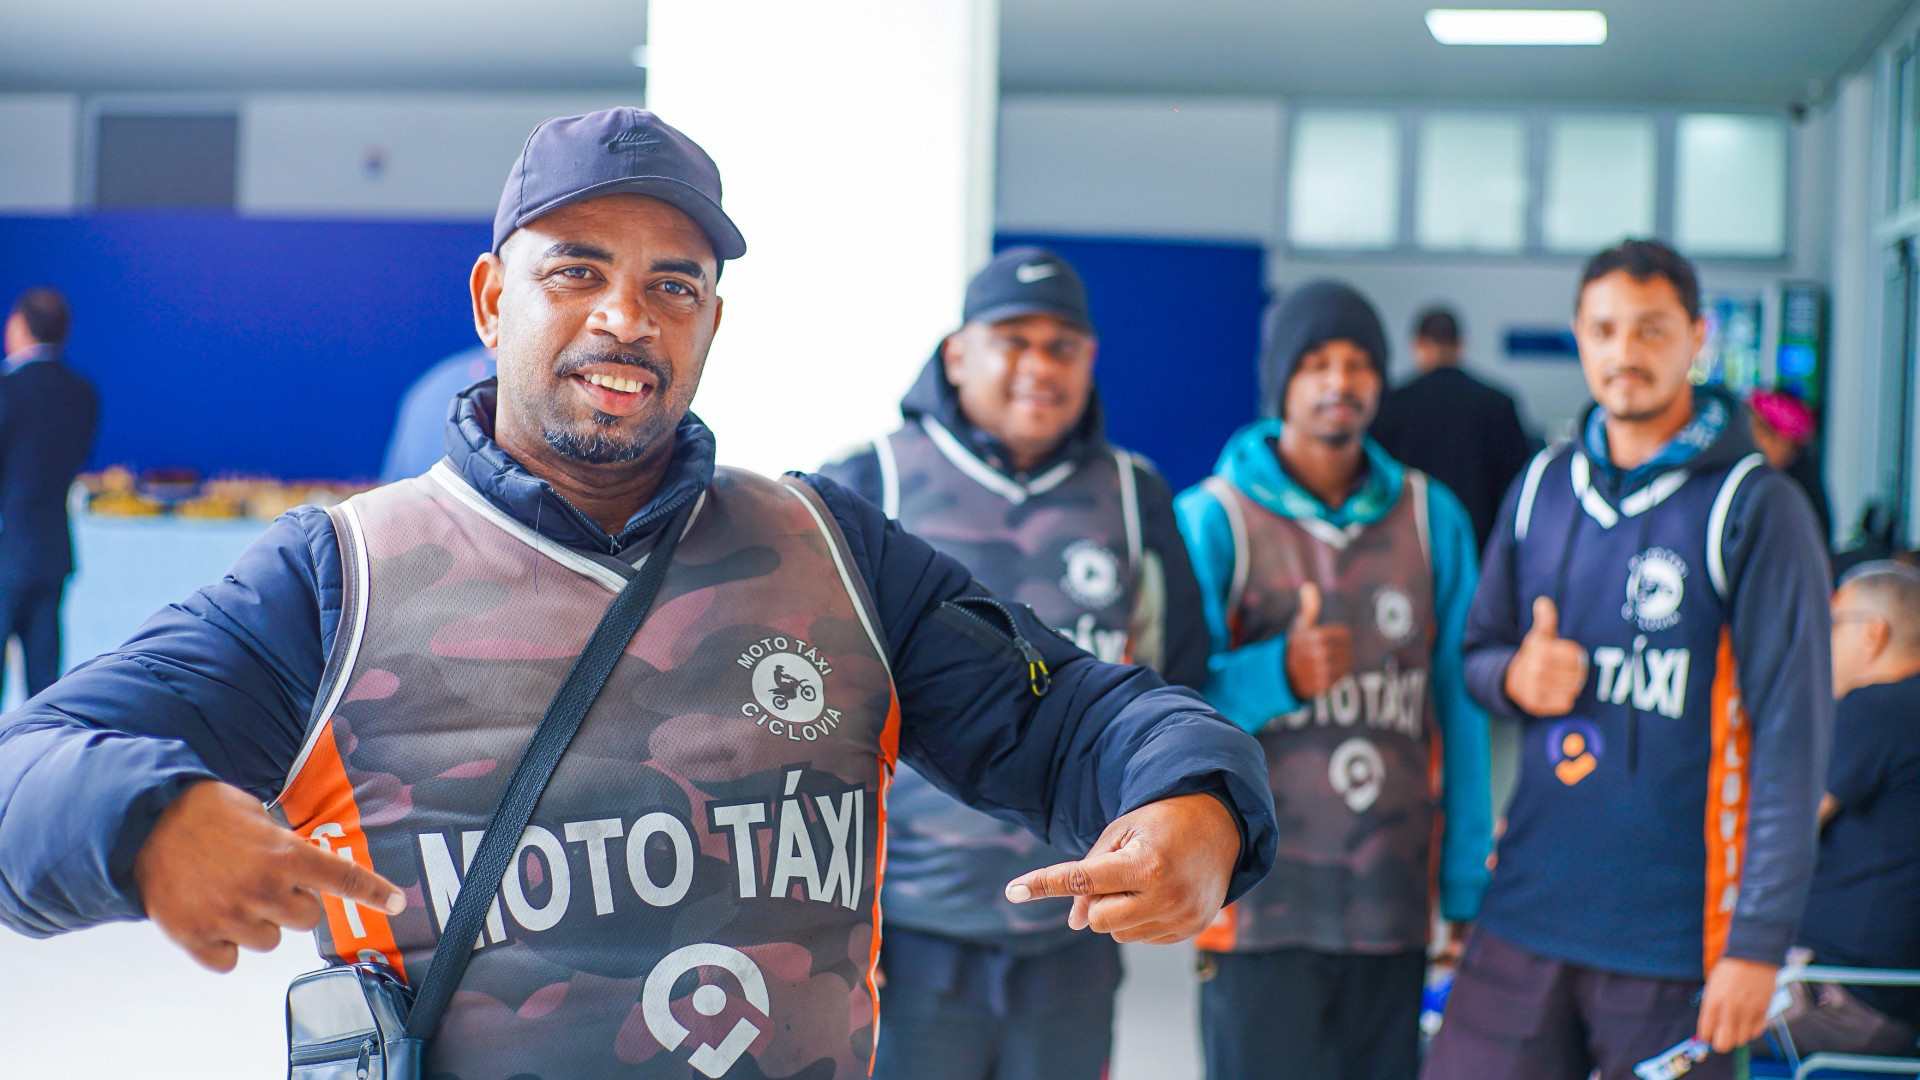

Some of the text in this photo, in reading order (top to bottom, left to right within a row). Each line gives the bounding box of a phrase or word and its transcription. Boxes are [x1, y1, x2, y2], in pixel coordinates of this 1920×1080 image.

[736, 636, 833, 676] MOTO TÁXI
[1593, 634, 1690, 719] TÁXI
[741, 702, 842, 741] CICLOVIA
[419, 811, 695, 950] MOTO
[713, 769, 865, 911] TÁXI
